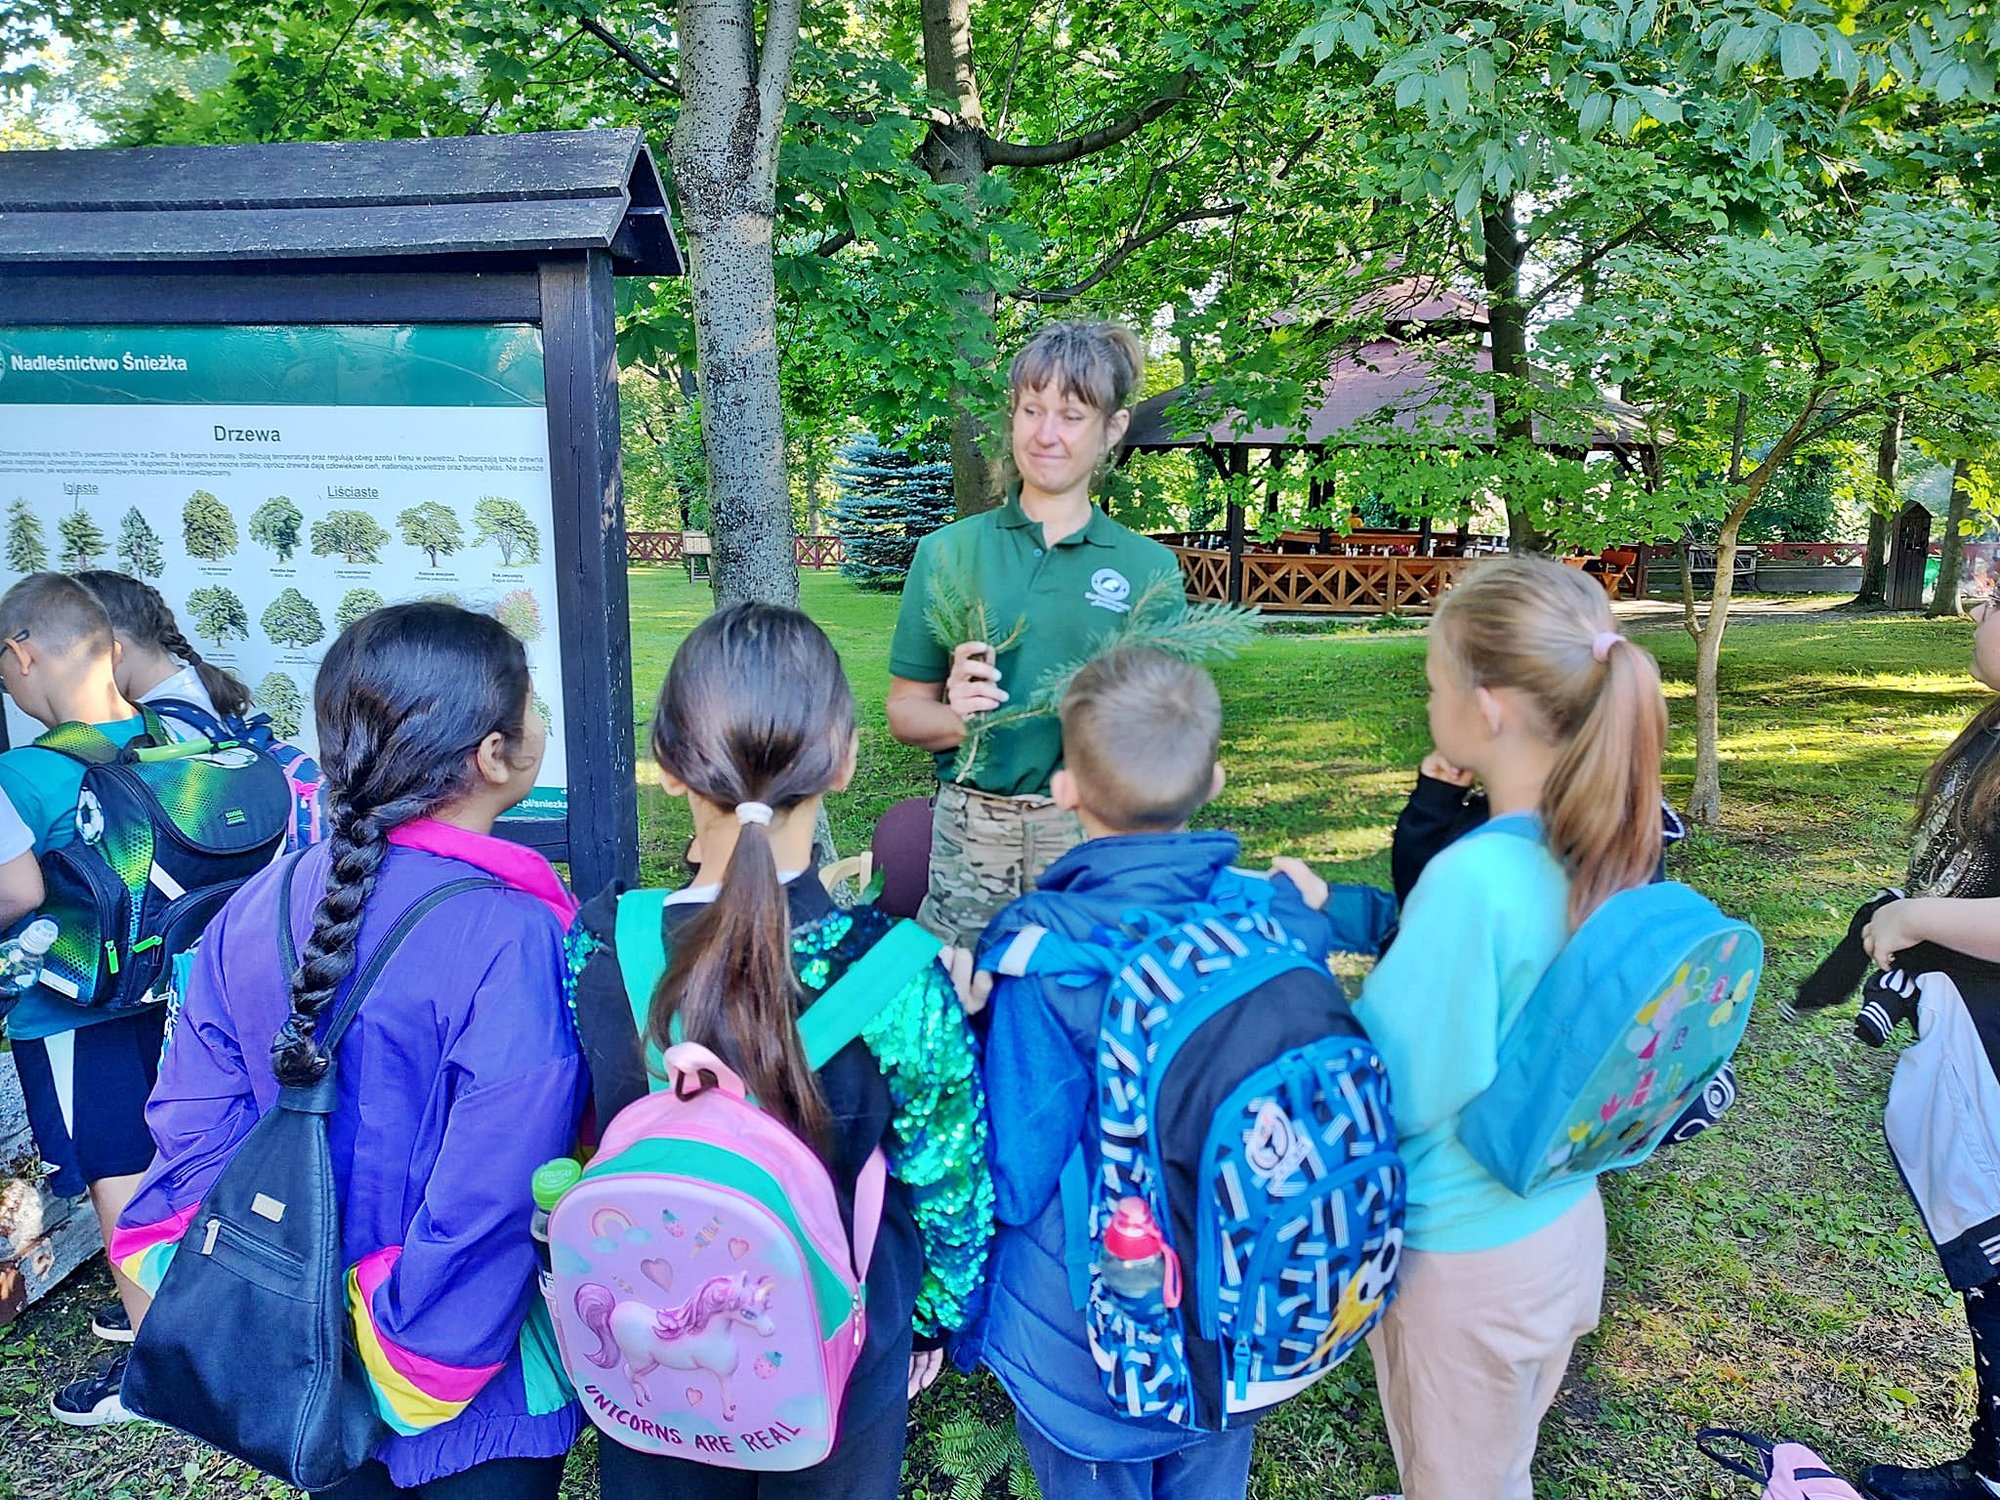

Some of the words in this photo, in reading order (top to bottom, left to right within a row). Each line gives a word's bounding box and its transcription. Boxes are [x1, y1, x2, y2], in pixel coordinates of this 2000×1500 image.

[10, 354, 119, 371] Nadleśnictwo
[122, 351, 188, 371] Śnieżka
[213, 425, 281, 441] Drzewa
[63, 482, 99, 495] Iglaste
[327, 486, 380, 499] Liściaste
[584, 1384, 683, 1445] UNICORNS
[694, 1432, 736, 1454] ARE
[740, 1420, 801, 1453] REAL
